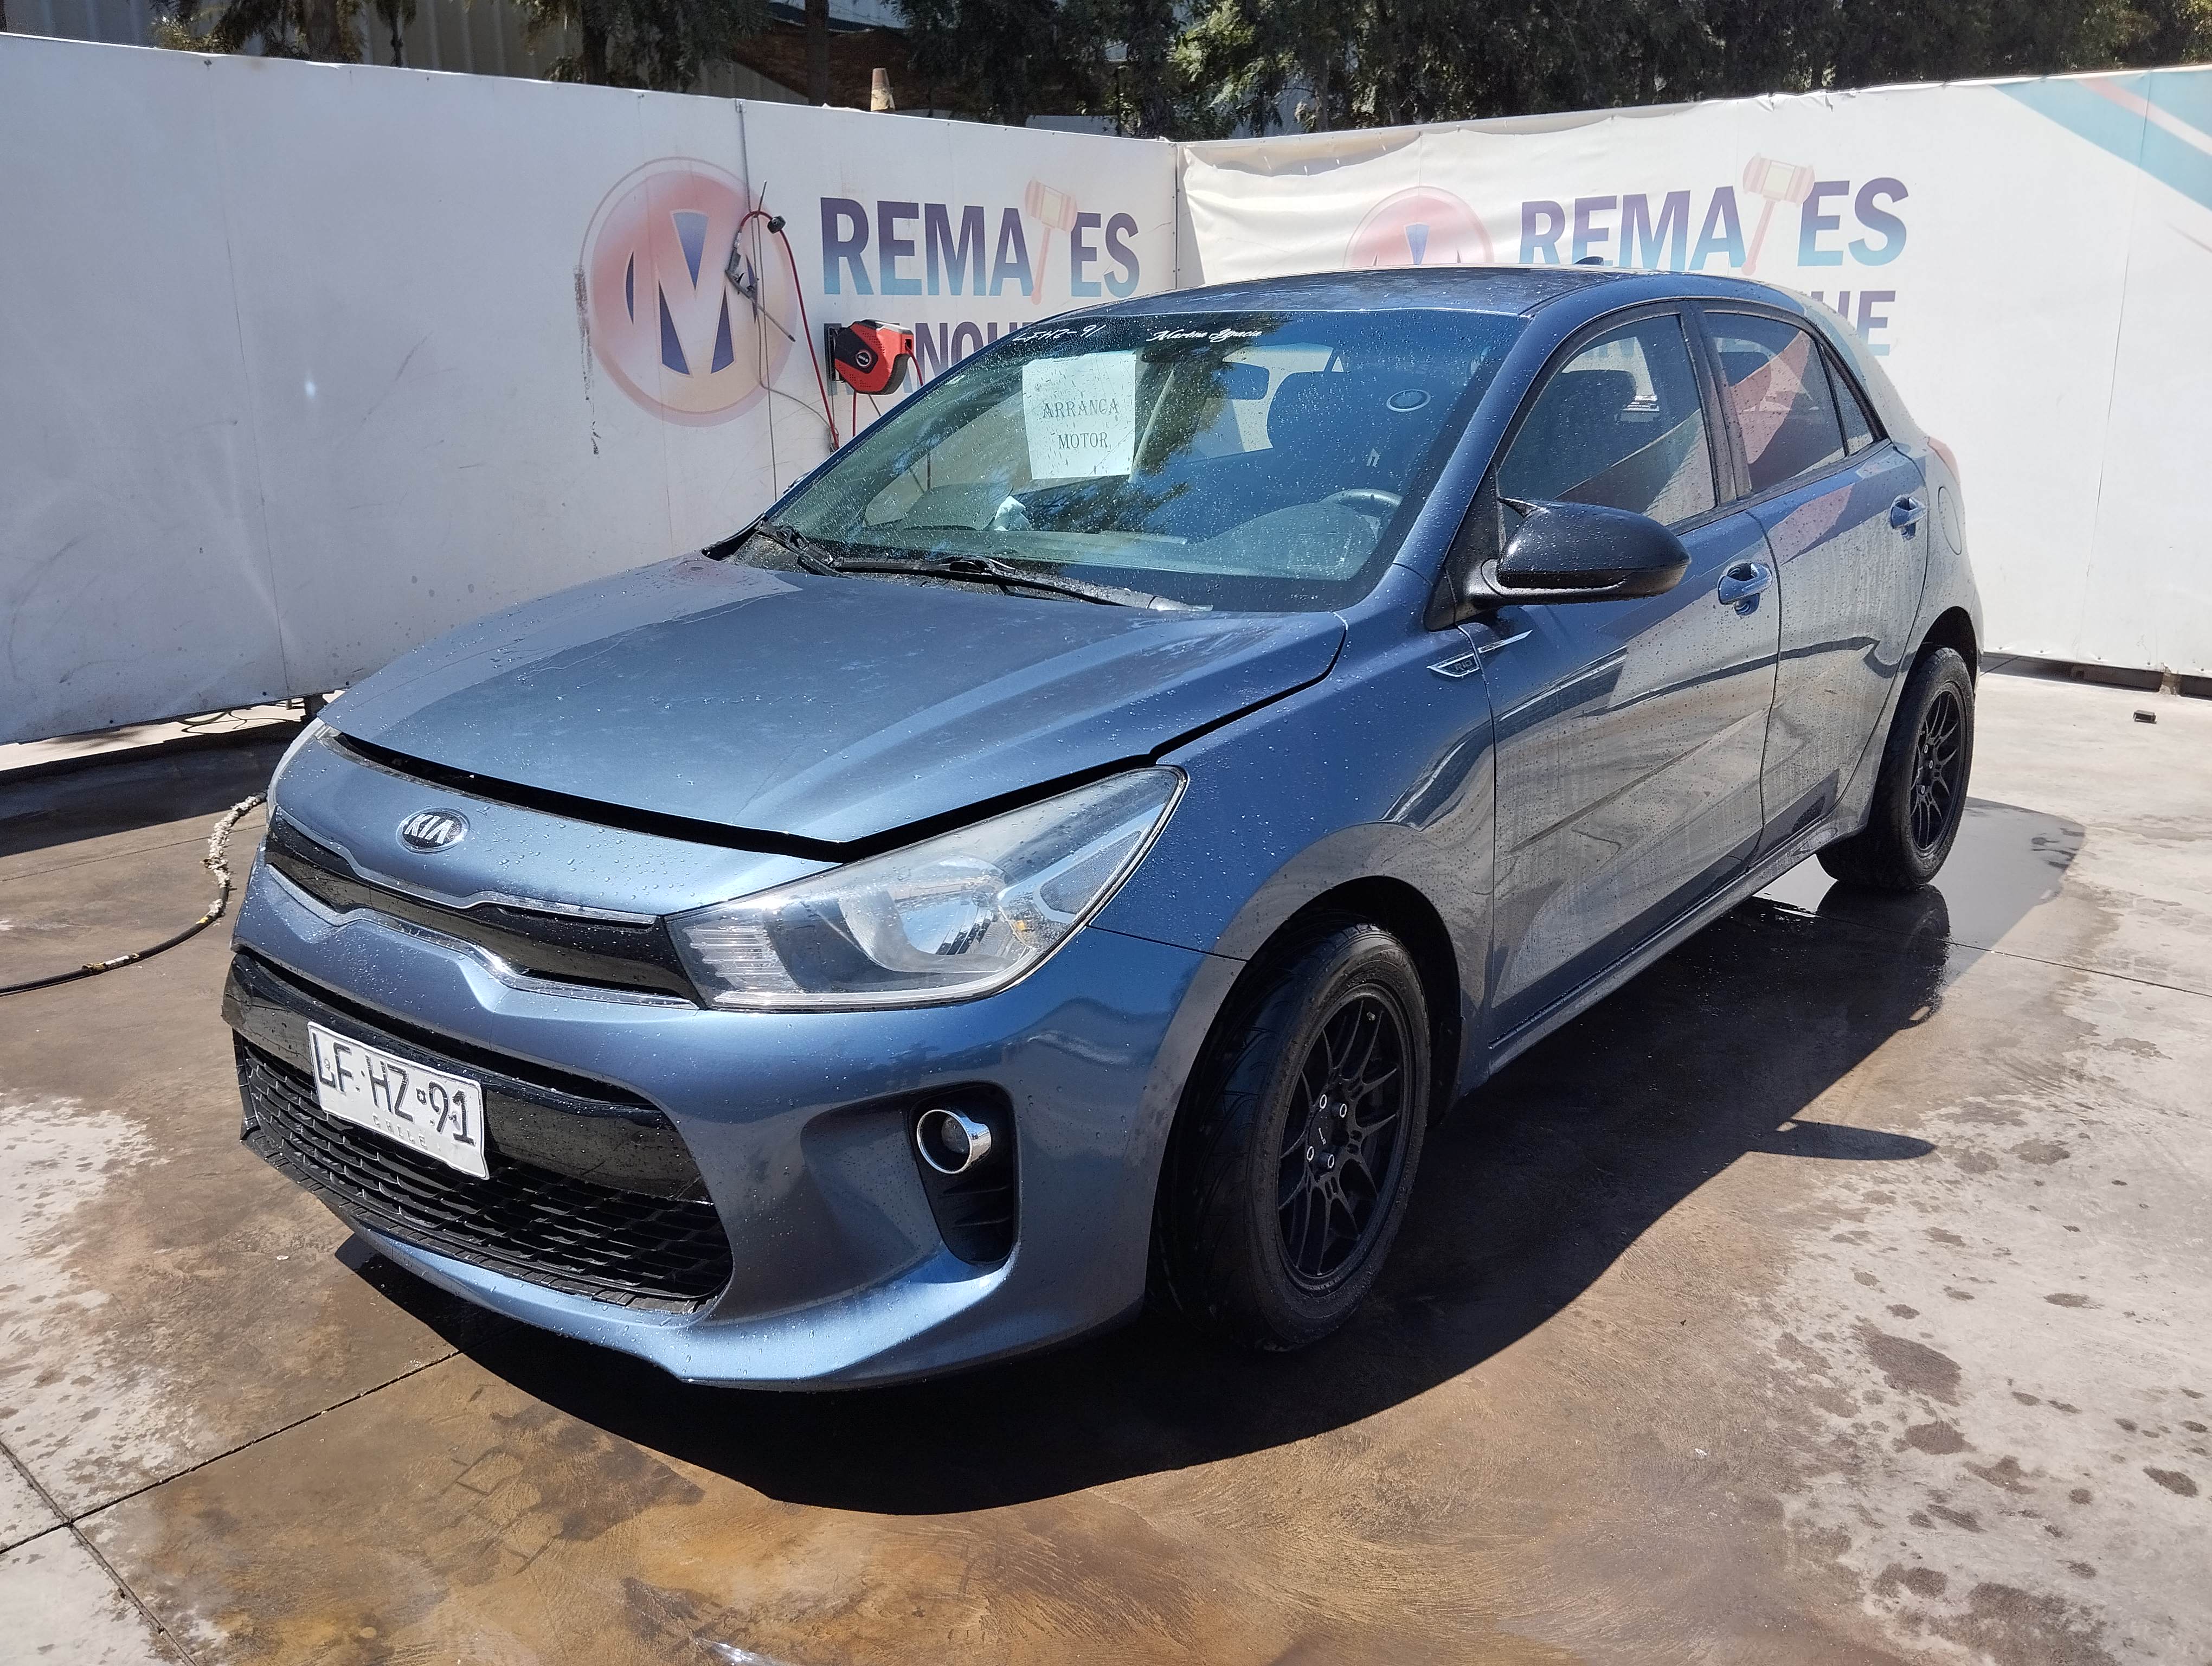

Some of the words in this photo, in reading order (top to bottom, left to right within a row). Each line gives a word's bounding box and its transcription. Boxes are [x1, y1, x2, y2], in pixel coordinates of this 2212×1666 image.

[1041, 398, 1120, 420] ARRANCA
[1058, 432, 1109, 450] MOTOR
[1454, 660, 1472, 671] RIO
[404, 813, 454, 844] KIA
